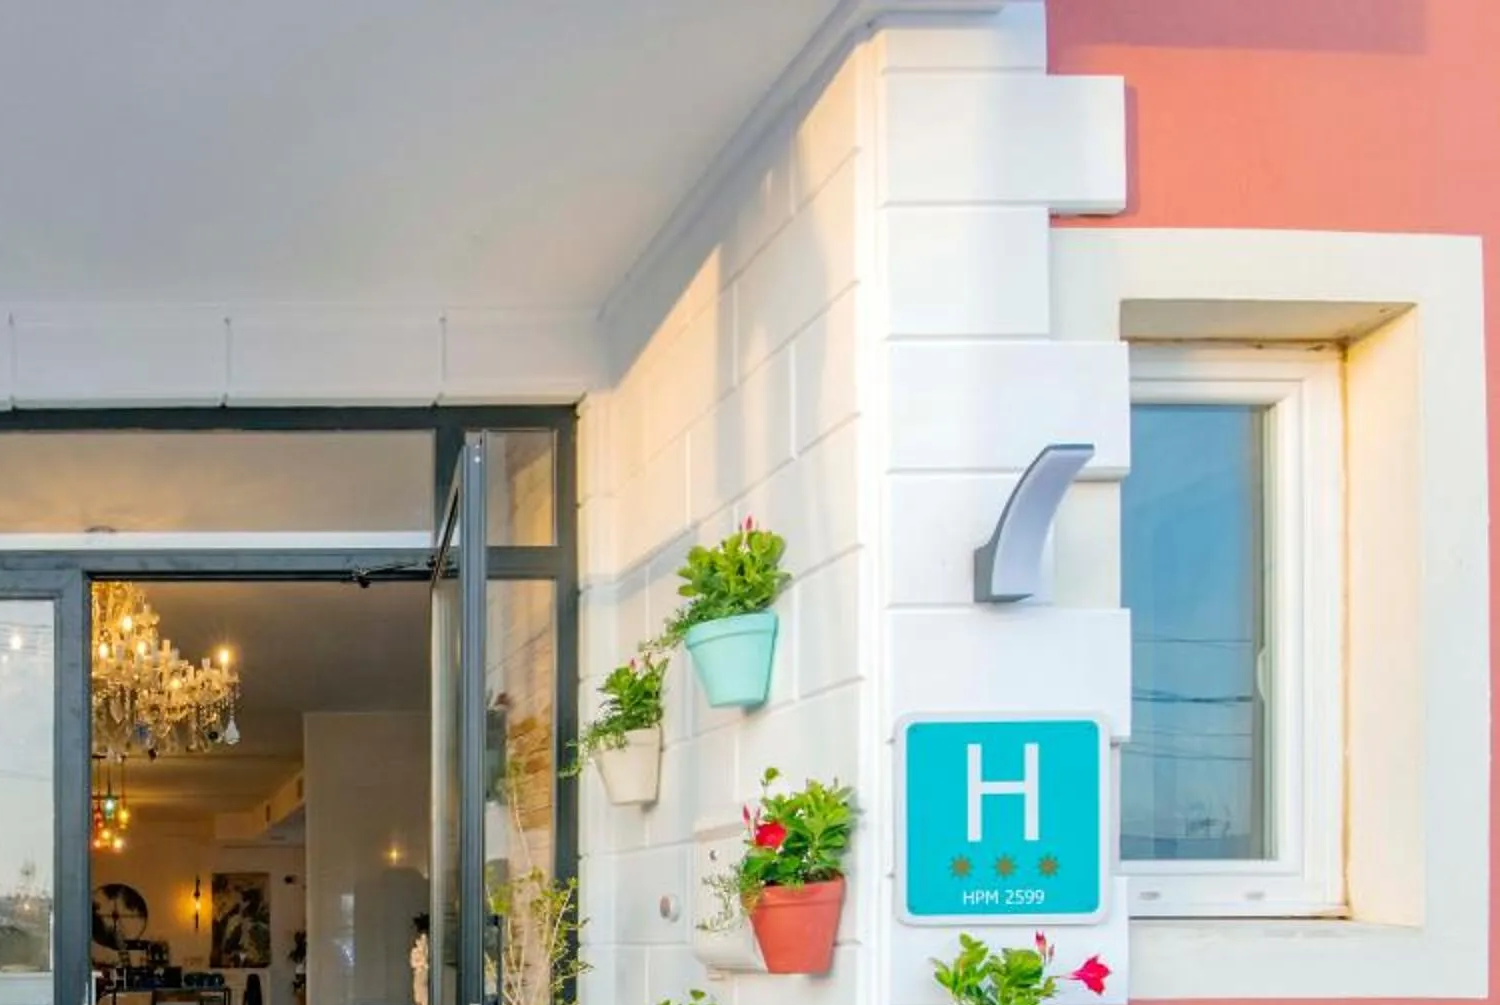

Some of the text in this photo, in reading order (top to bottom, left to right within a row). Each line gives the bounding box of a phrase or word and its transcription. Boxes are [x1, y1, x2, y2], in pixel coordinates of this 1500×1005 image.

[967, 743, 1039, 842] H
[962, 888, 1045, 905] HPM 2599
